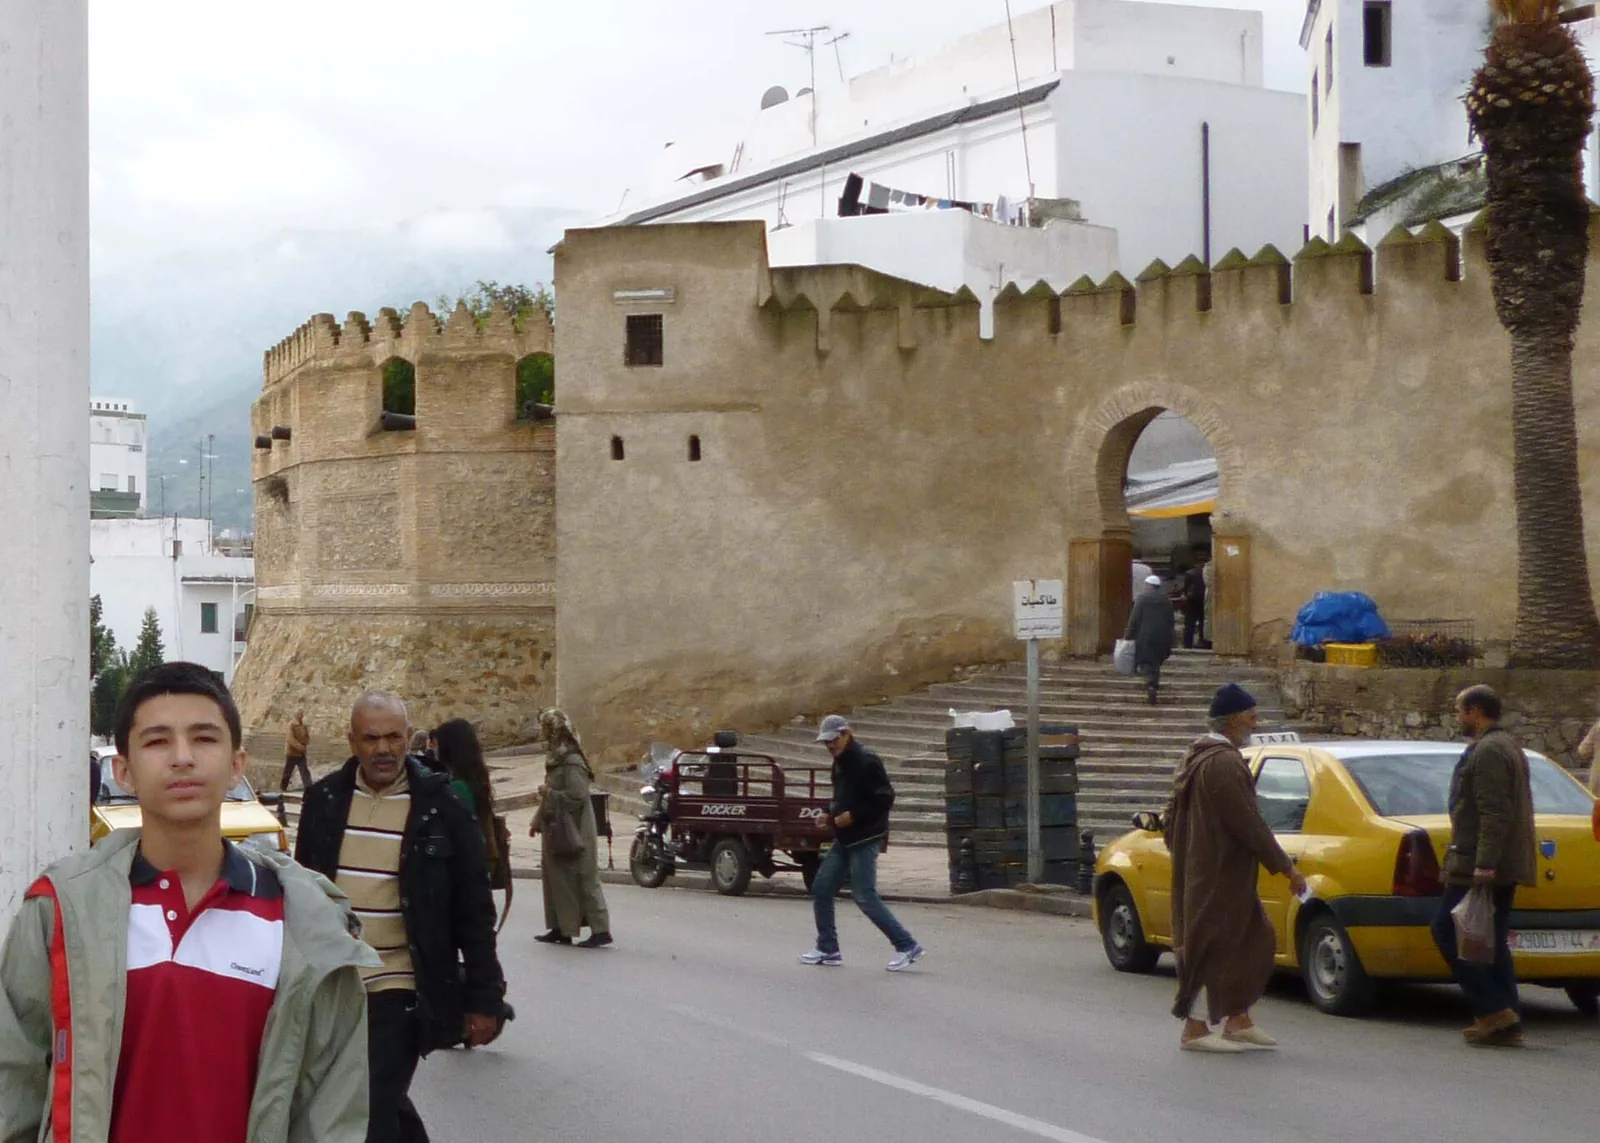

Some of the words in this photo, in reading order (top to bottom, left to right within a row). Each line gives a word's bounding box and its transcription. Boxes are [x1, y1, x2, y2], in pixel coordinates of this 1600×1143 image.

[1256, 734, 1296, 744] TAXI
[701, 804, 747, 816] DOCKER
[799, 807, 824, 819] DO
